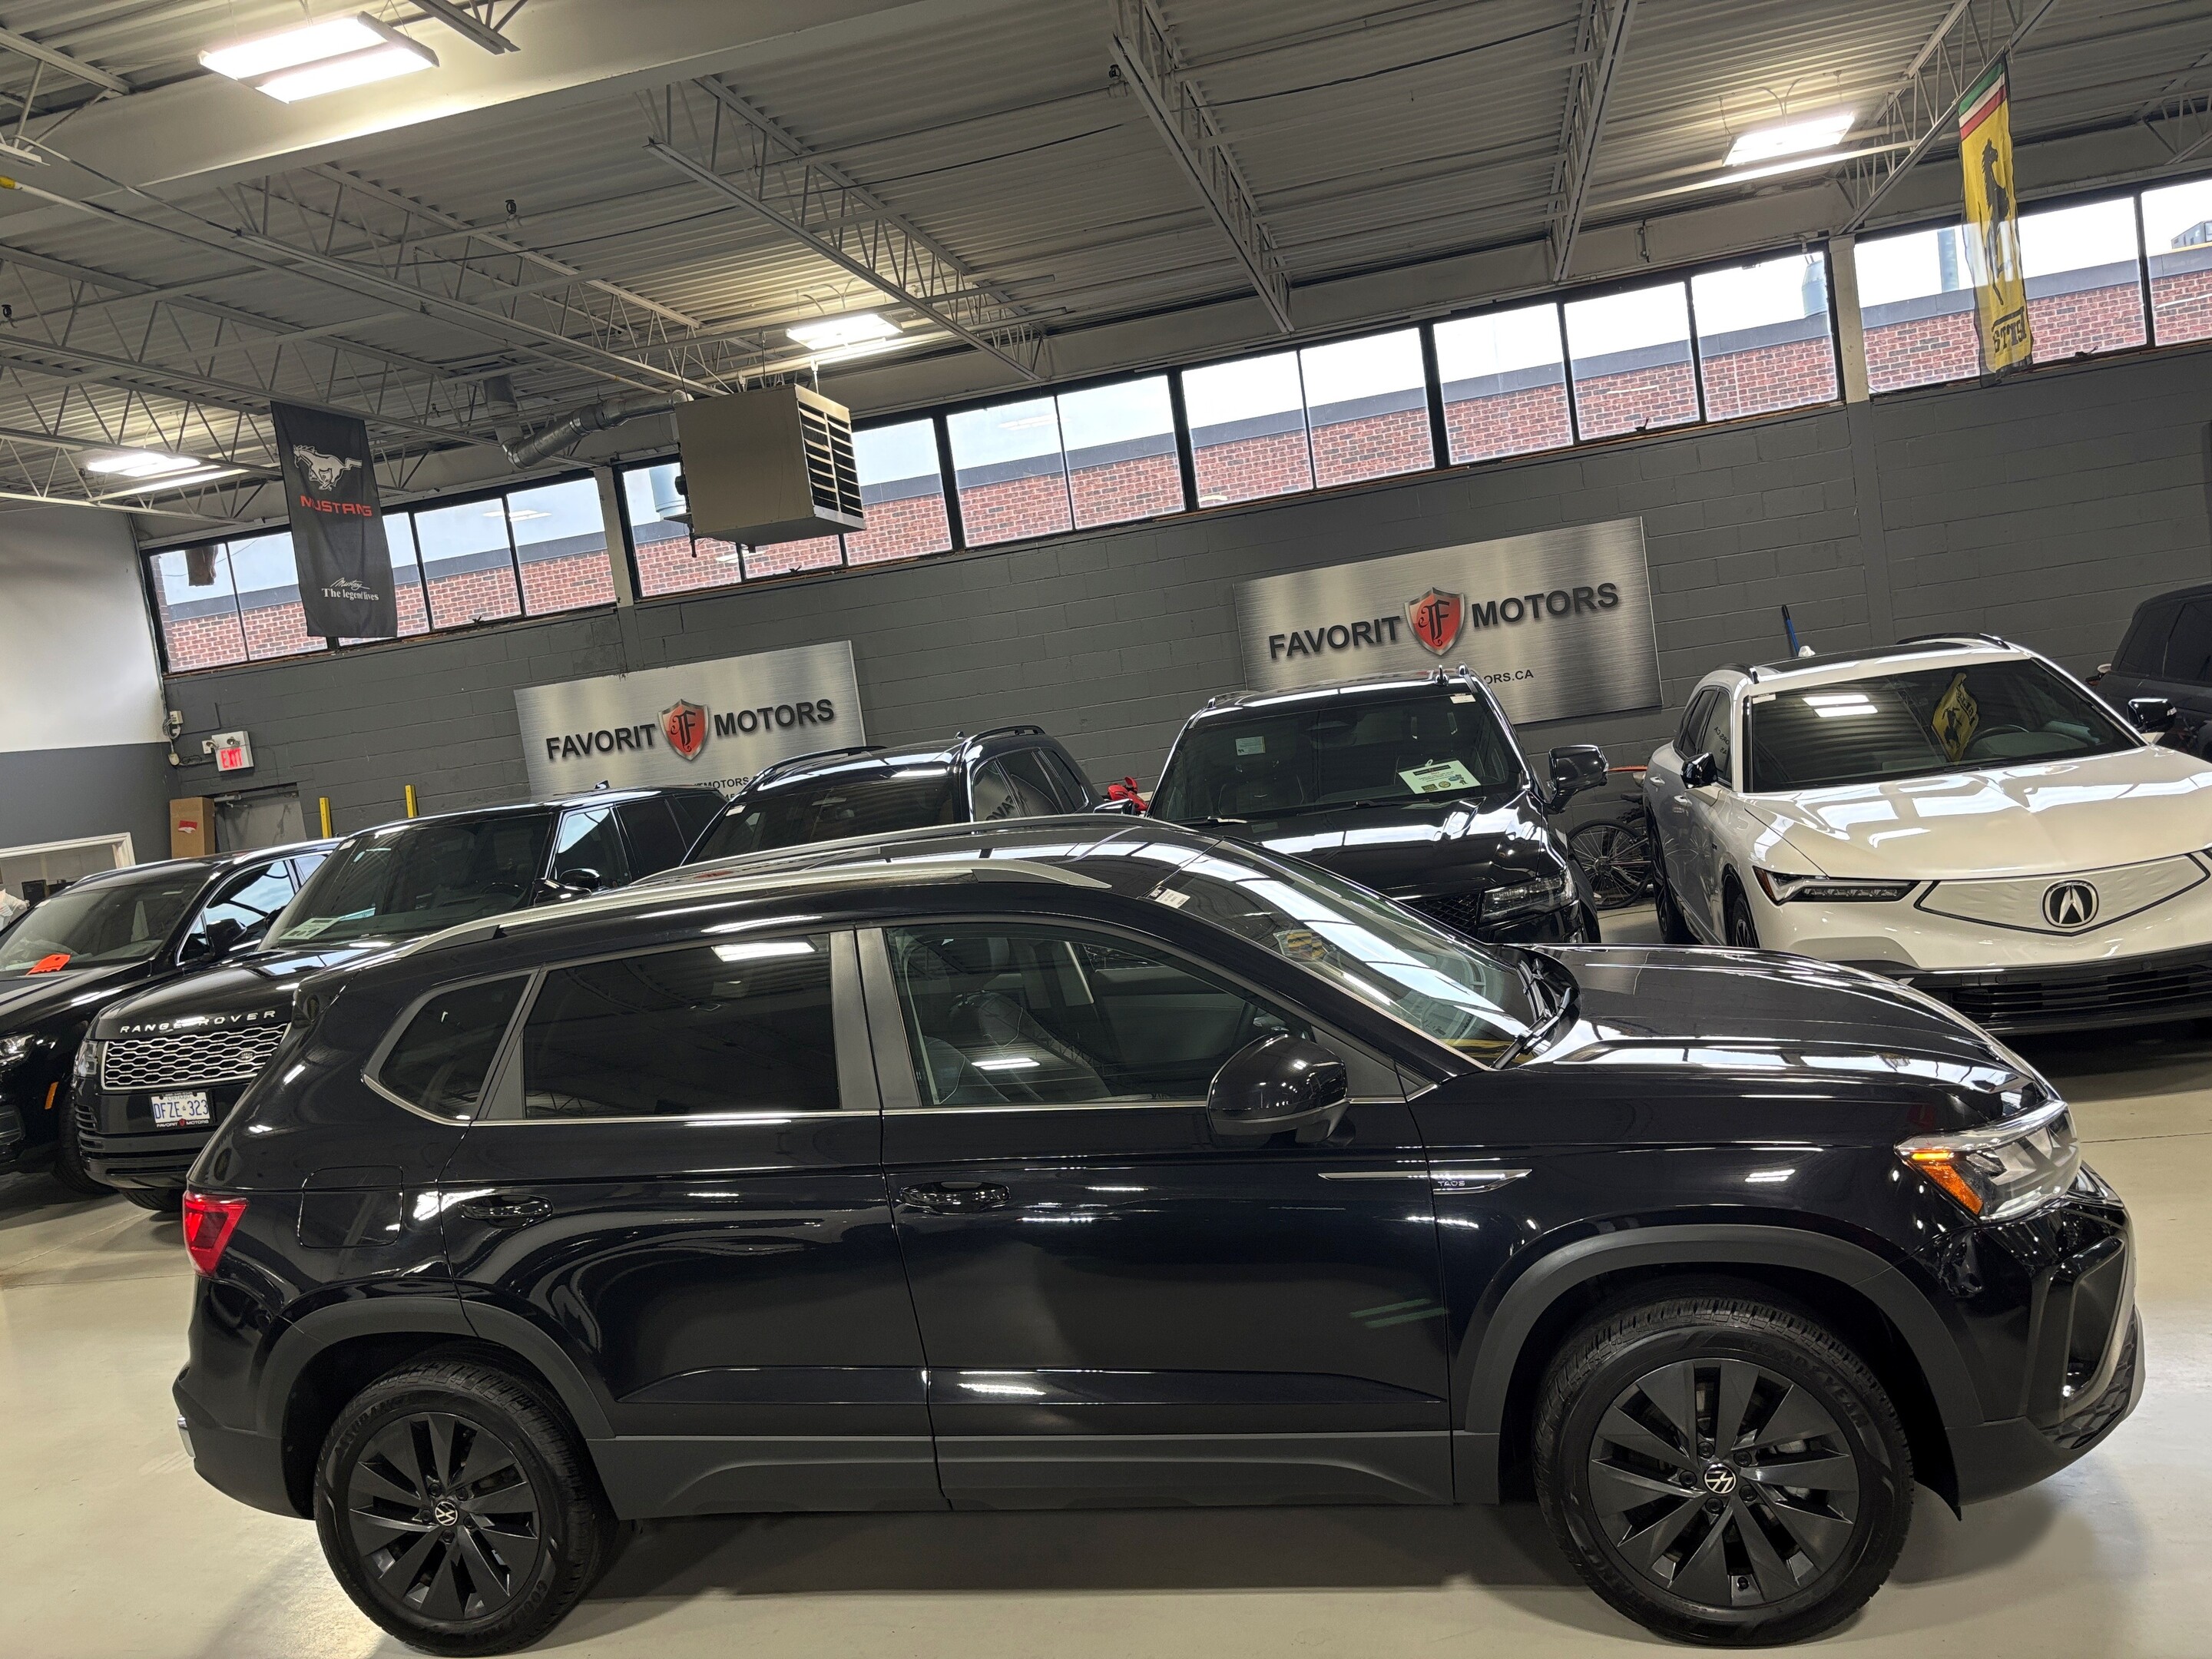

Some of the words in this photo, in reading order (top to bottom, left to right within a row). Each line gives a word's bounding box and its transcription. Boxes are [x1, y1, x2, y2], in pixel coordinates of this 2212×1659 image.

[300, 495, 373, 517] MUSTANG
[322, 588, 341, 598] The
[343, 589, 363, 601] legend
[363, 591, 379, 601] lives
[1269, 615, 1402, 659] FAVORIT
[1472, 582, 1619, 628] MOTORS
[1484, 670, 1535, 684] ORS.CA
[545, 723, 656, 760] FAVORIT
[714, 699, 835, 737] MOTORS
[220, 747, 243, 769] EXIT
[120, 1022, 183, 1033] RANGE
[198, 1010, 276, 1026] ROVER
[187, 1099, 209, 1116] 323
